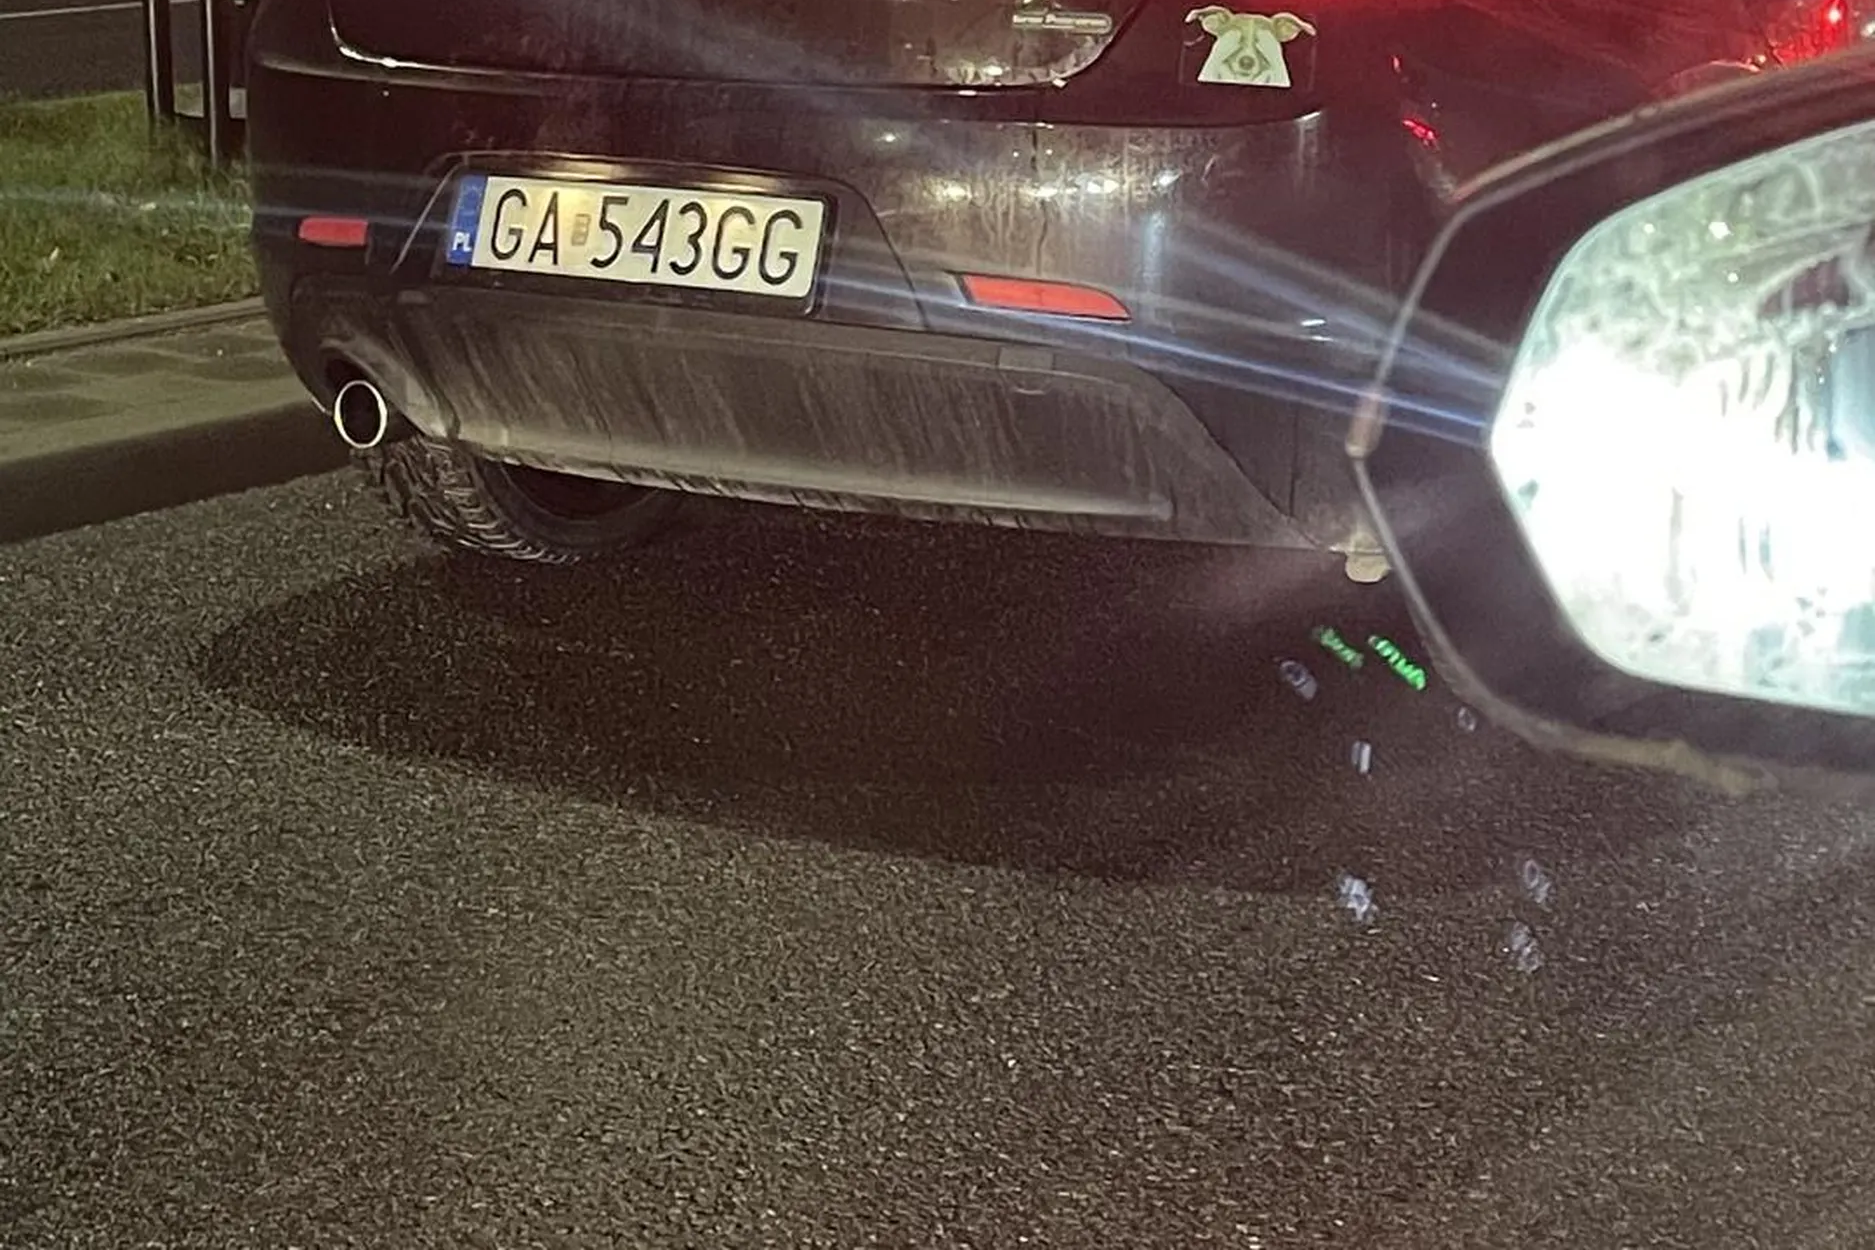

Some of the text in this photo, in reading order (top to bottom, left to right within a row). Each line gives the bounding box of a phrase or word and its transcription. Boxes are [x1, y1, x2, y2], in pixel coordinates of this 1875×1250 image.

[452, 231, 472, 253] PL
[490, 188, 559, 265] GA
[590, 195, 803, 286] 543GG
